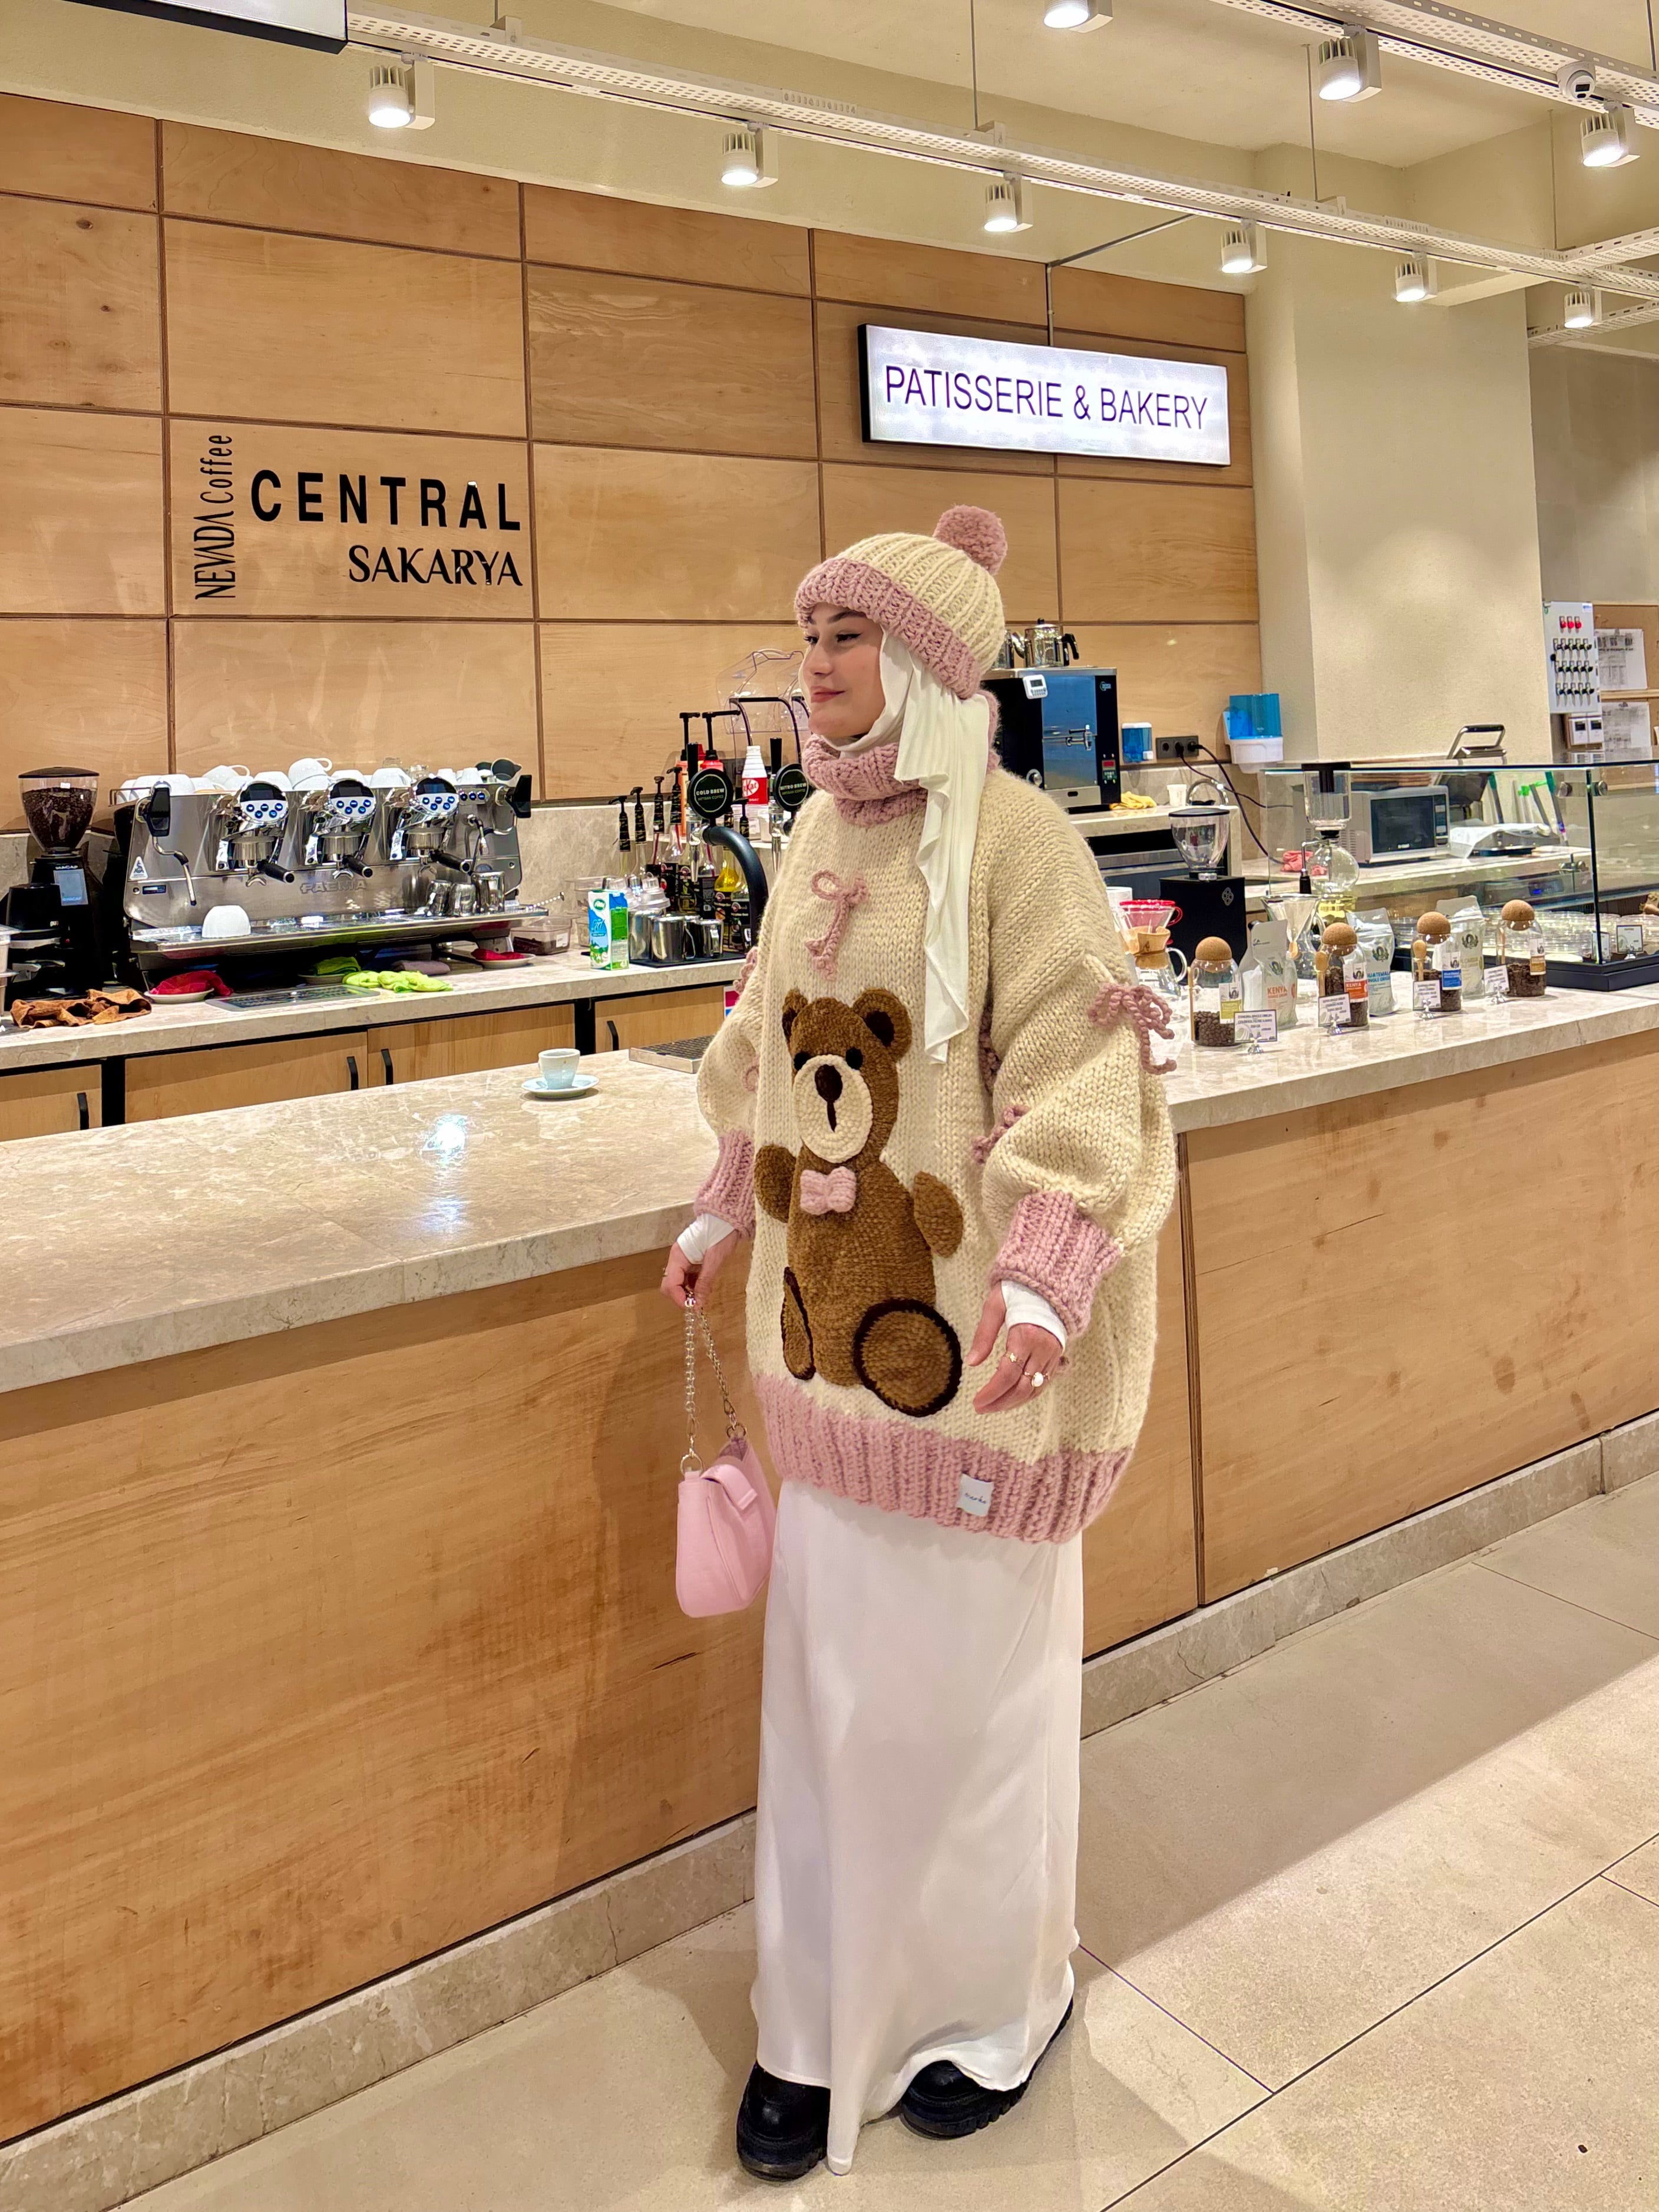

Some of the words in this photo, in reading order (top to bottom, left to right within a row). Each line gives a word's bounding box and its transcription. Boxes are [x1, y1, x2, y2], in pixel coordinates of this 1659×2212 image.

[885, 364, 1064, 418] PATISSERIE
[1073, 384, 1092, 421] &
[1100, 388, 1208, 430] BAKERY
[200, 434, 233, 504] Coffee
[250, 469, 521, 531] CENTRAL
[193, 510, 236, 600] NEVADA
[348, 544, 524, 587] SAKARYA
[300, 879, 367, 894] FAEMA
[1267, 985, 1288, 995] KENYA
